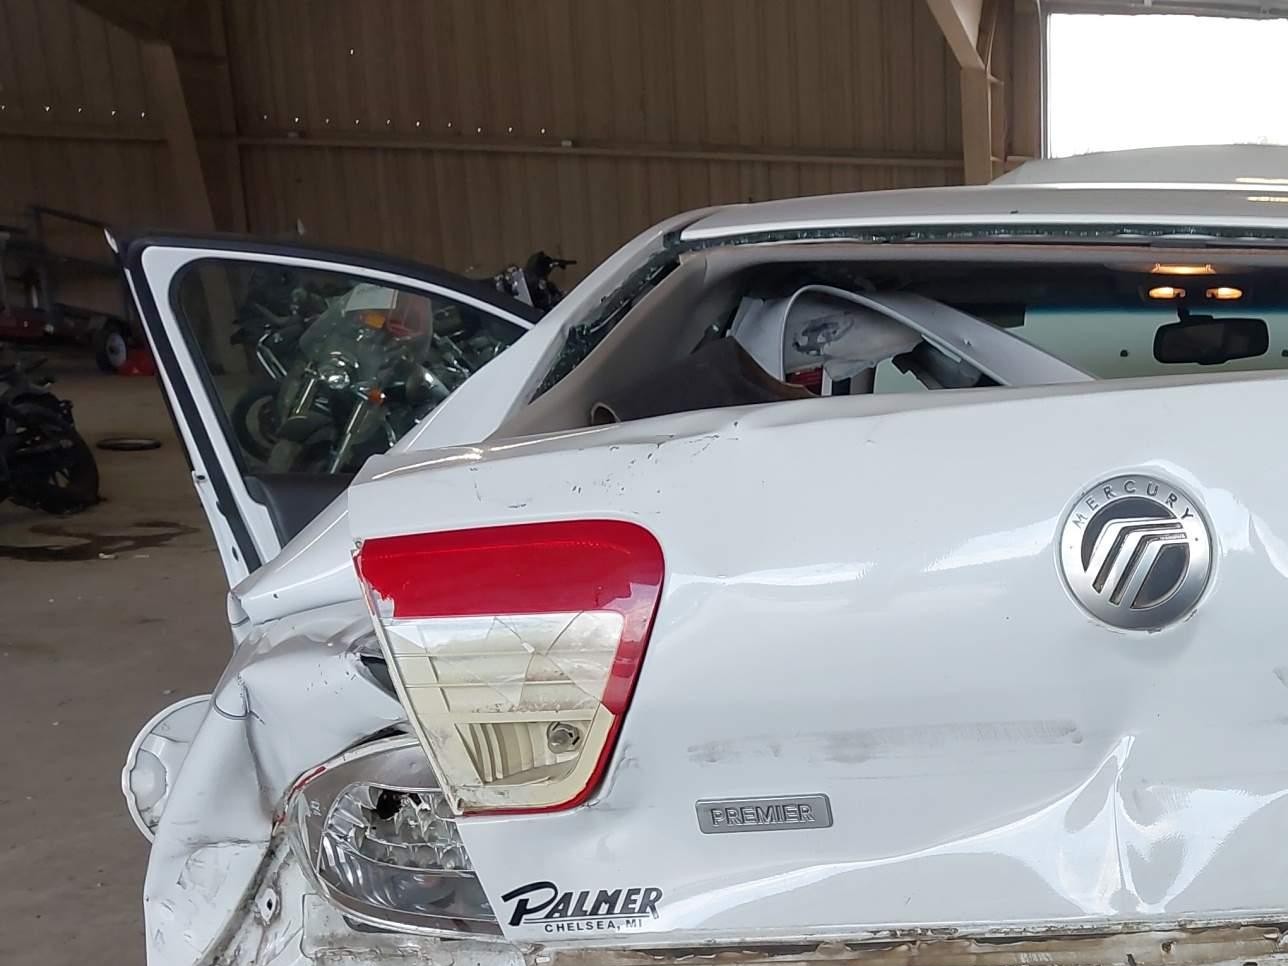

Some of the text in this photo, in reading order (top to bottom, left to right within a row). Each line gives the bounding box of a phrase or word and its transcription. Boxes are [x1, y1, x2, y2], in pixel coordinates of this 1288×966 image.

[1072, 479, 1194, 529] MERCURY
[710, 803, 816, 827] PREMIER
[501, 881, 663, 926] PALMER
[544, 921, 621, 933] CHELSEA,
